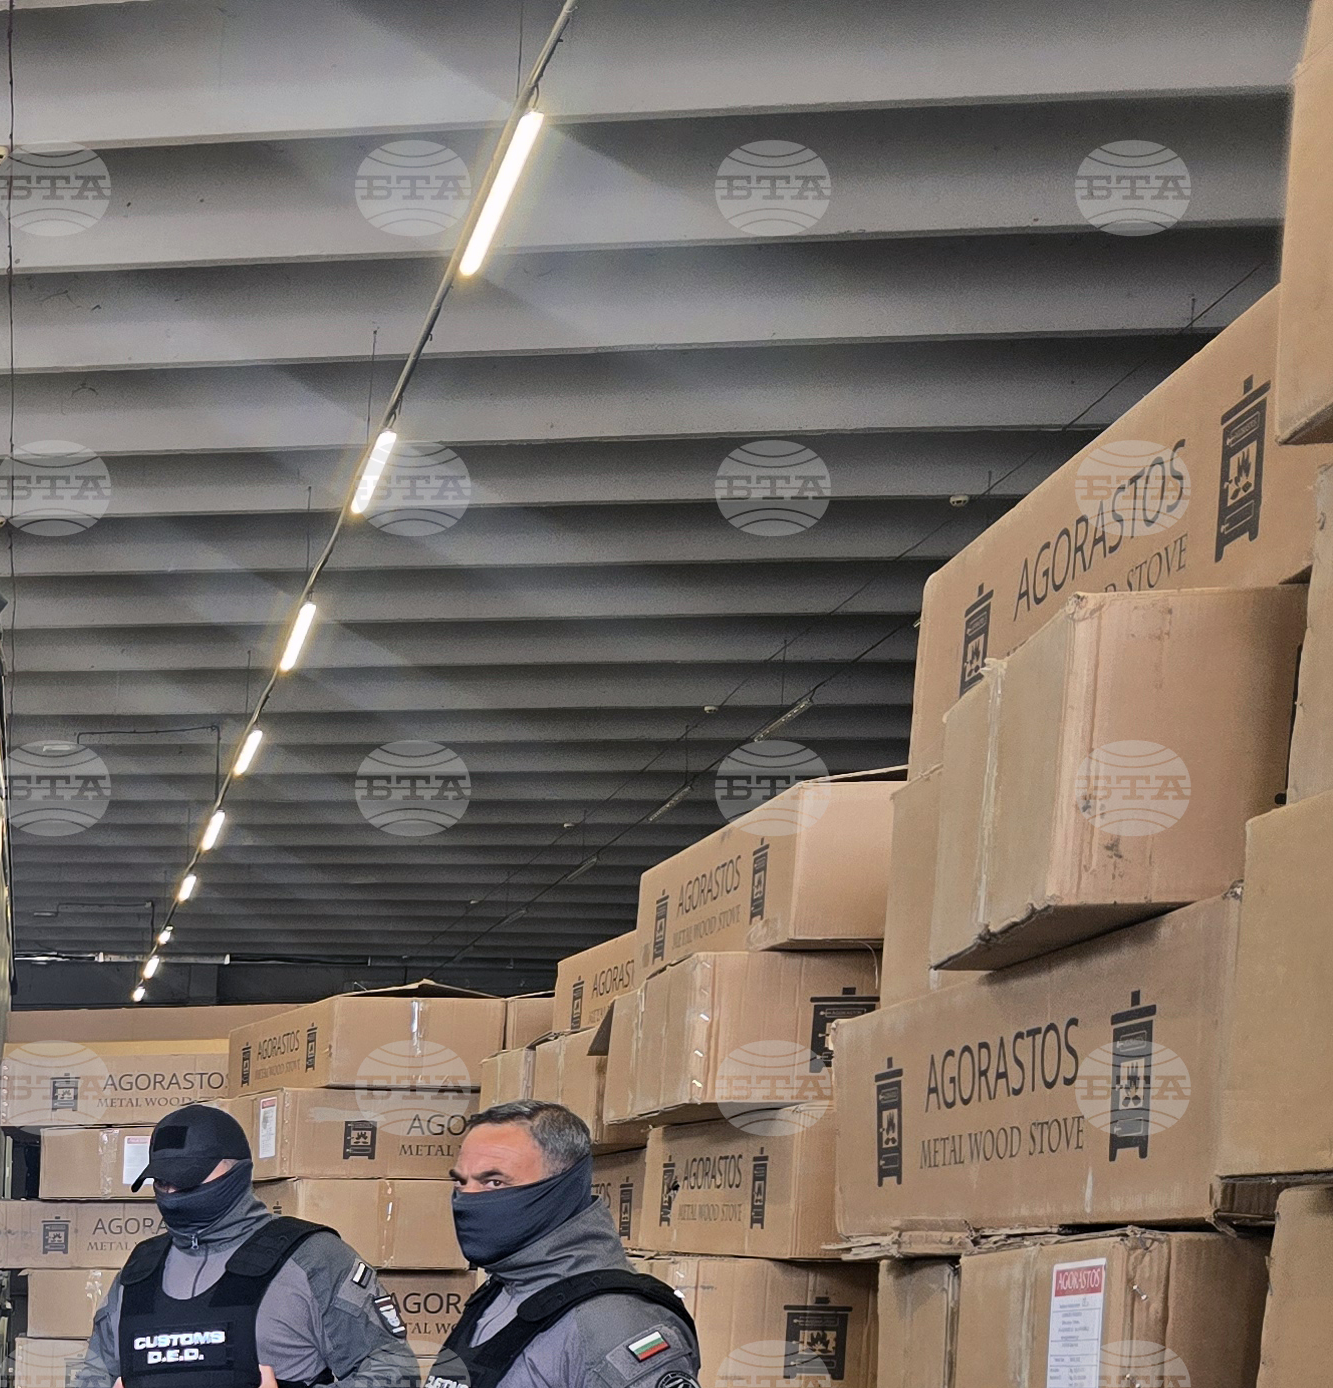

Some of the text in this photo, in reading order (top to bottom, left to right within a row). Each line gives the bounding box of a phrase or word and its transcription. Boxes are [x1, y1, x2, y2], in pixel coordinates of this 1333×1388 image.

[1013, 439, 1186, 622] AGORASTOS
[676, 855, 742, 918] AGORASTOS
[256, 1030, 300, 1061] AGORASTOS
[924, 1017, 1079, 1113] AGORASTOS
[103, 1072, 229, 1092] AGORASTO
[96, 1098, 142, 1108] METAL
[399, 1144, 453, 1157] METAL
[919, 1116, 1084, 1170] METAL WOOD STOVE
[683, 1154, 743, 1190] AGORASTOS
[699, 1203, 719, 1222] WOOD
[721, 1203, 743, 1222] STOVE
[86, 1241, 131, 1251] METAL
[1056, 1267, 1101, 1291] AGORASTOS
[134, 1330, 225, 1350] CUSTOMS
[147, 1348, 204, 1365] D.E.D.
